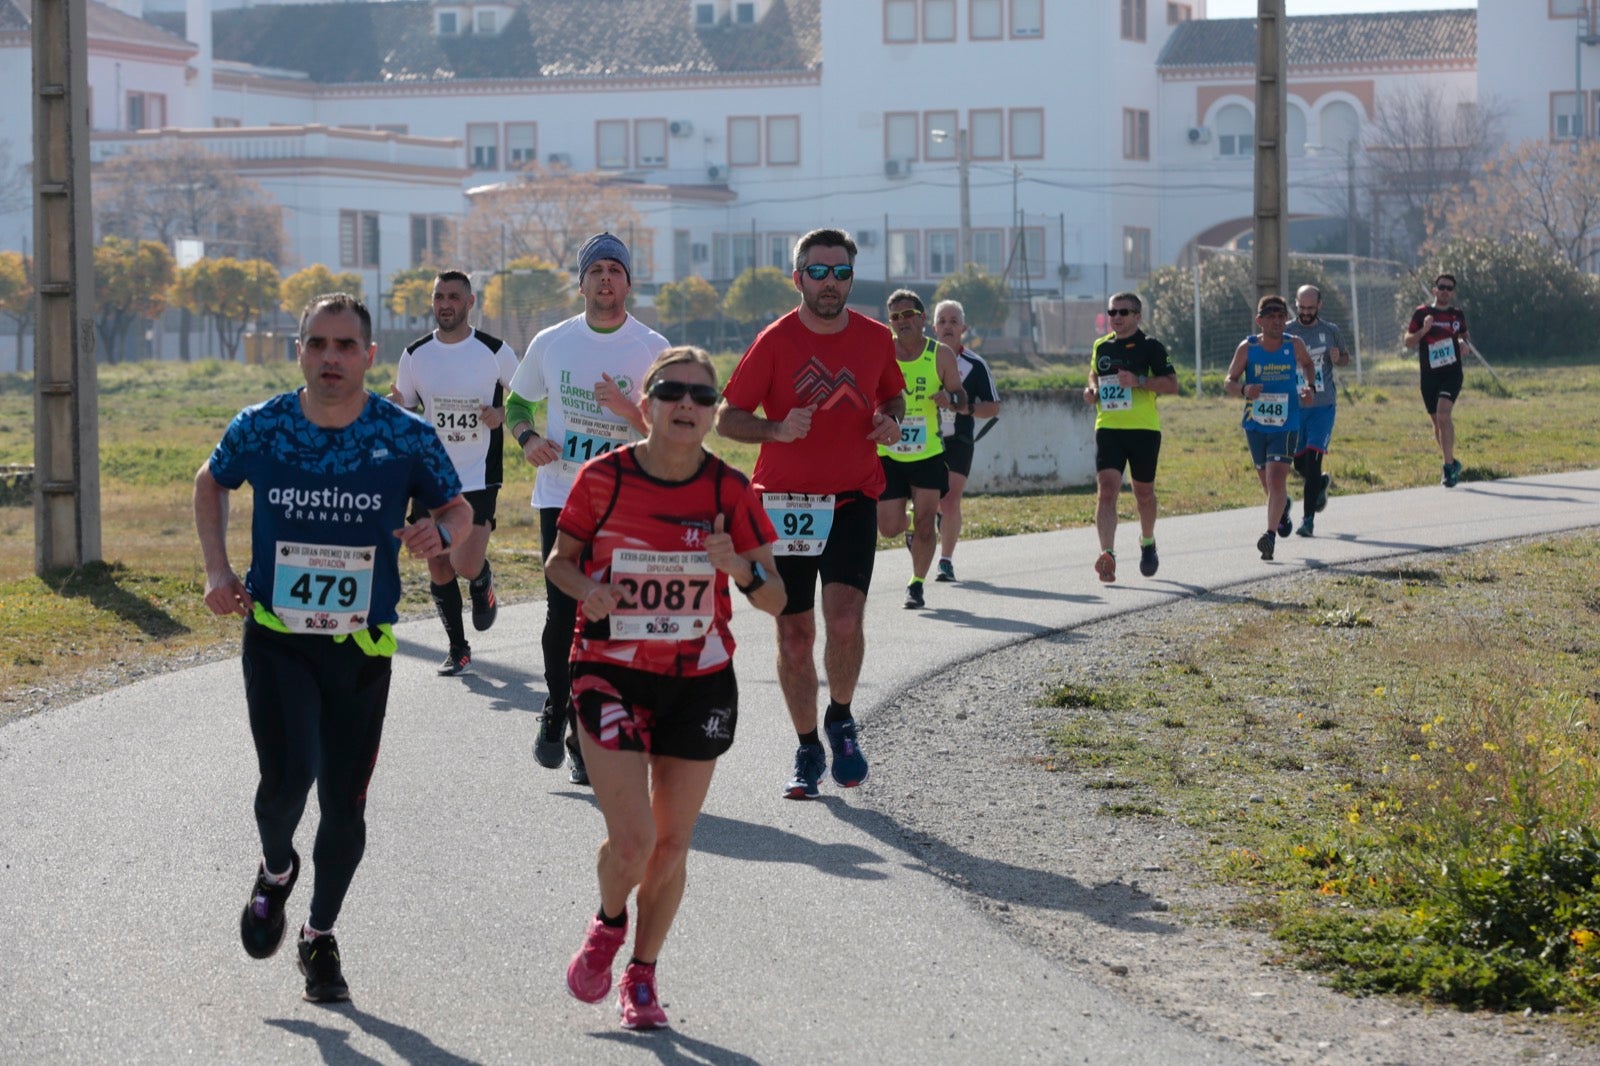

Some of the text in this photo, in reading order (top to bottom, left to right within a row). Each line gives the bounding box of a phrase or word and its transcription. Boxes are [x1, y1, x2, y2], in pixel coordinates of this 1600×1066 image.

[1431, 347, 1451, 360] 287
[561, 370, 571, 384] II
[560, 384, 596, 401] CARRE
[1101, 386, 1125, 400] 322
[1257, 403, 1283, 416] 448
[436, 412, 478, 429] 3143
[567, 435, 625, 461] 114
[268, 487, 382, 512] agustinos
[285, 510, 363, 523] GRANADA
[783, 513, 814, 536] 92
[290, 573, 358, 607] 479
[616, 578, 710, 610] 2087
